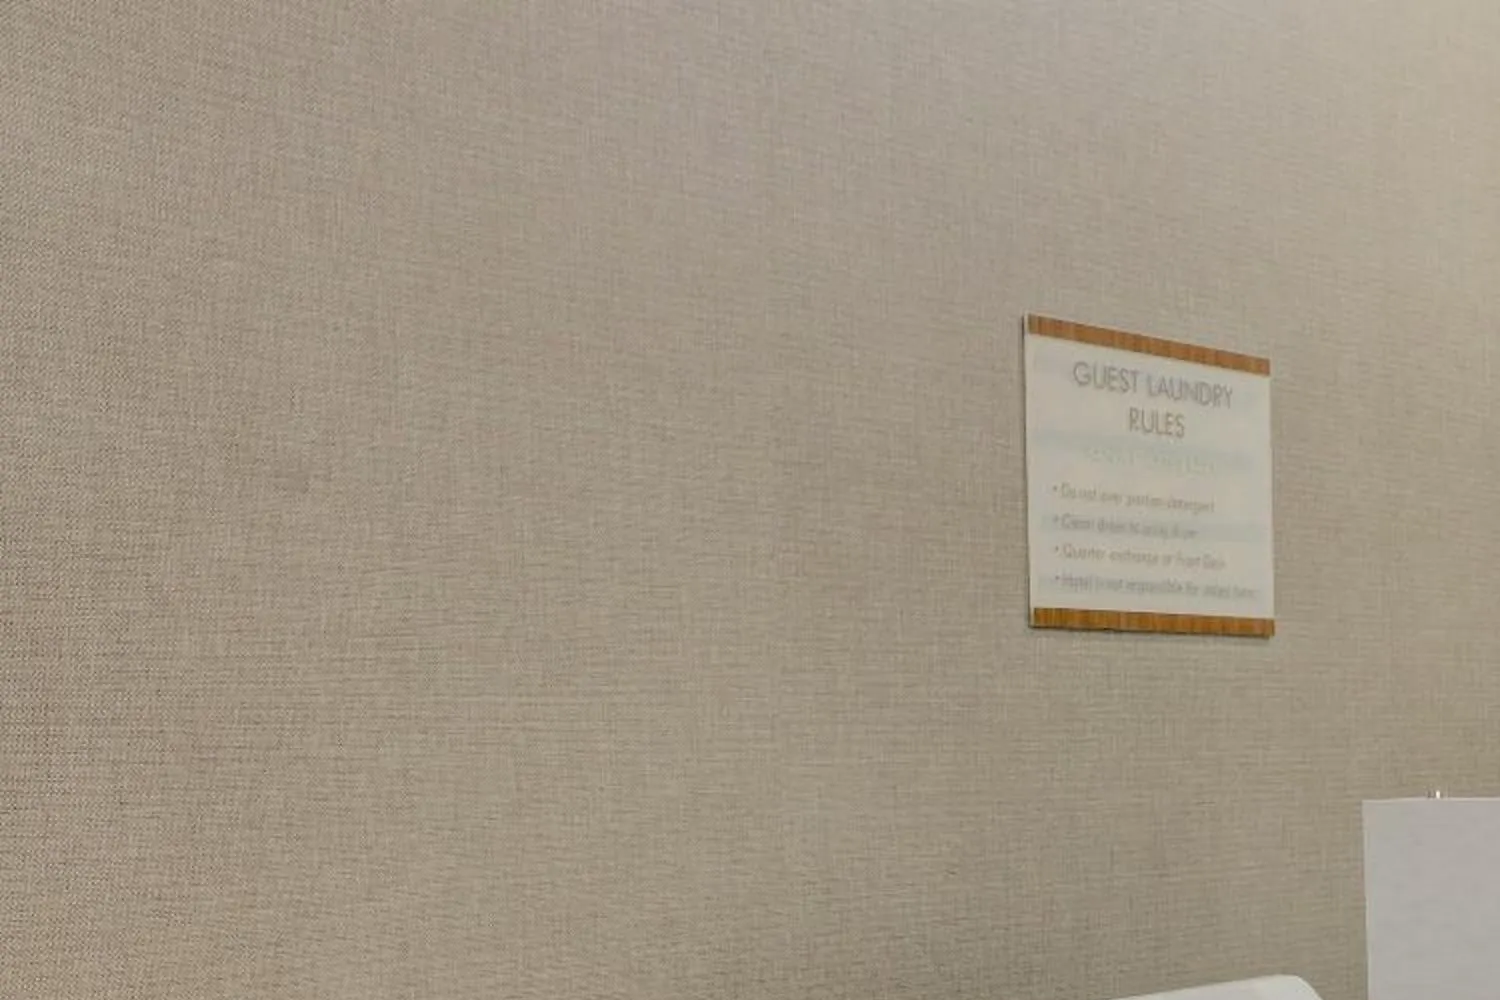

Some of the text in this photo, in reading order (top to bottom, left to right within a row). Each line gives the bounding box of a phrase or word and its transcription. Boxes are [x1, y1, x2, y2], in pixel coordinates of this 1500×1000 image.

[1073, 361, 1233, 408] GUEST LAUNDRY
[1129, 406, 1185, 438] RULES
